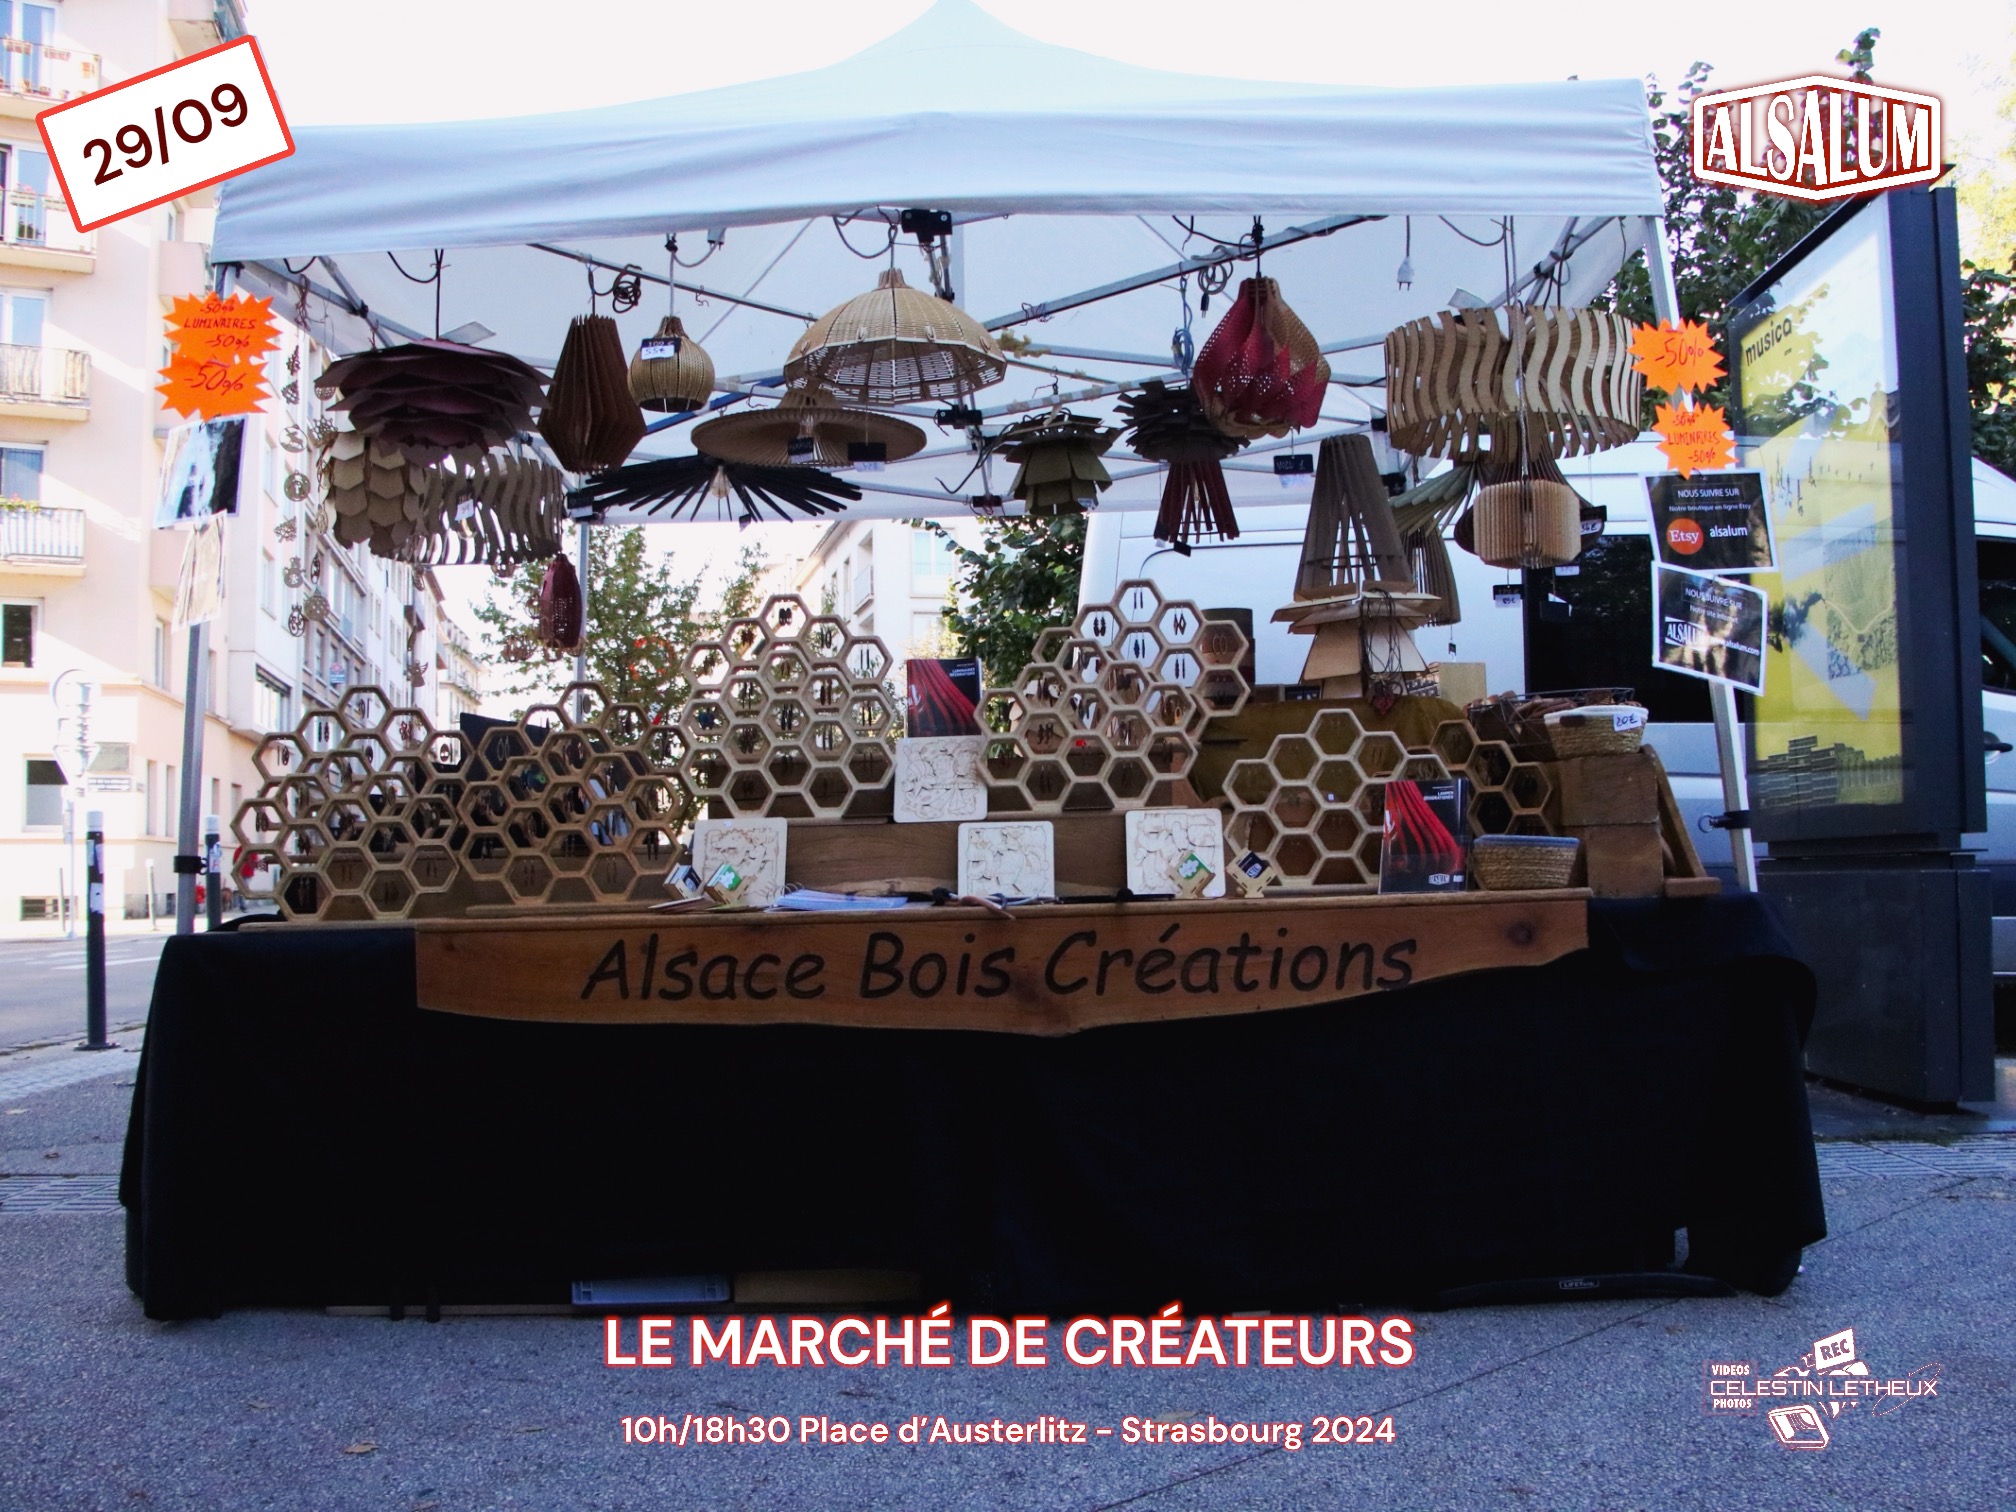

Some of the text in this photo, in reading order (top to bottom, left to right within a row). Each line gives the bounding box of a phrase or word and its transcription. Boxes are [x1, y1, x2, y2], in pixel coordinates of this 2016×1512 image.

[183, 316, 257, 329] LUMINAIRES
[1745, 317, 1792, 367] musica
[1654, 337, 1704, 368] -50%
[183, 364, 247, 396] -50%
[1667, 430, 1720, 446] LUMINAIRES
[1677, 488, 1740, 498] NOUS SUIVRE SUR
[1687, 504, 1713, 512] boutique
[1723, 503, 1738, 511] ligne
[1738, 503, 1751, 511] Etsy
[1669, 529, 1699, 544] Etsy
[1709, 524, 1748, 538] alsalum
[1704, 592, 1729, 607] SUIVRE
[1667, 622, 1706, 646] ALSALU
[1616, 713, 1638, 727] 20€
[580, 922, 1418, 1002] Alsace Bois Créations
